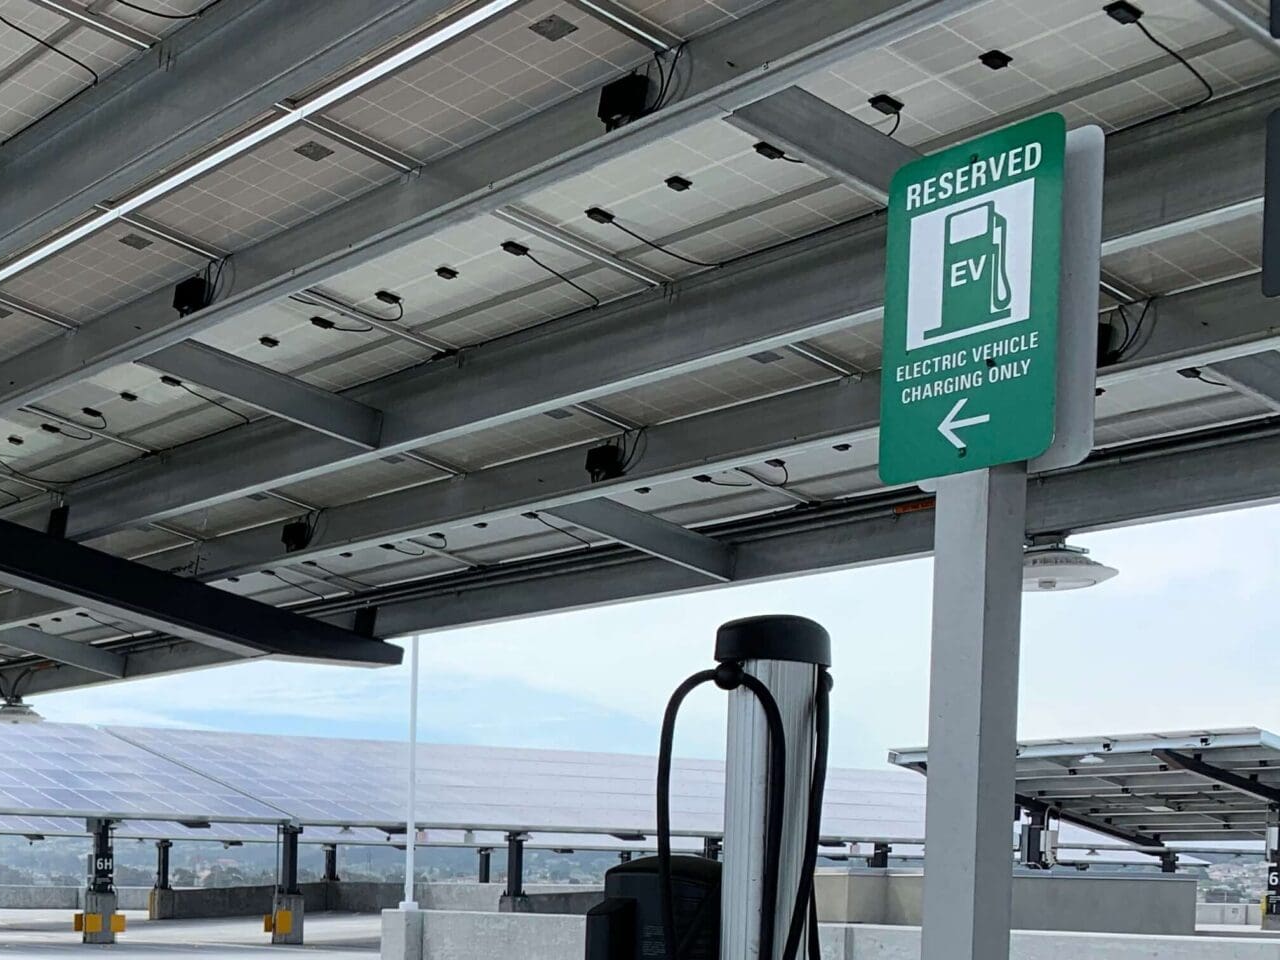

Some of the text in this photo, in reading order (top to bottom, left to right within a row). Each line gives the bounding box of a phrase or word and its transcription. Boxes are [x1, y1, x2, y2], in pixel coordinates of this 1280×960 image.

[906, 142, 1042, 211] RESERVED
[950, 254, 987, 287] EV
[896, 331, 1039, 382] ELECTRIC VEHICLE
[901, 358, 1031, 404] CHARGING ONLY
[96, 858, 113, 870] 6H
